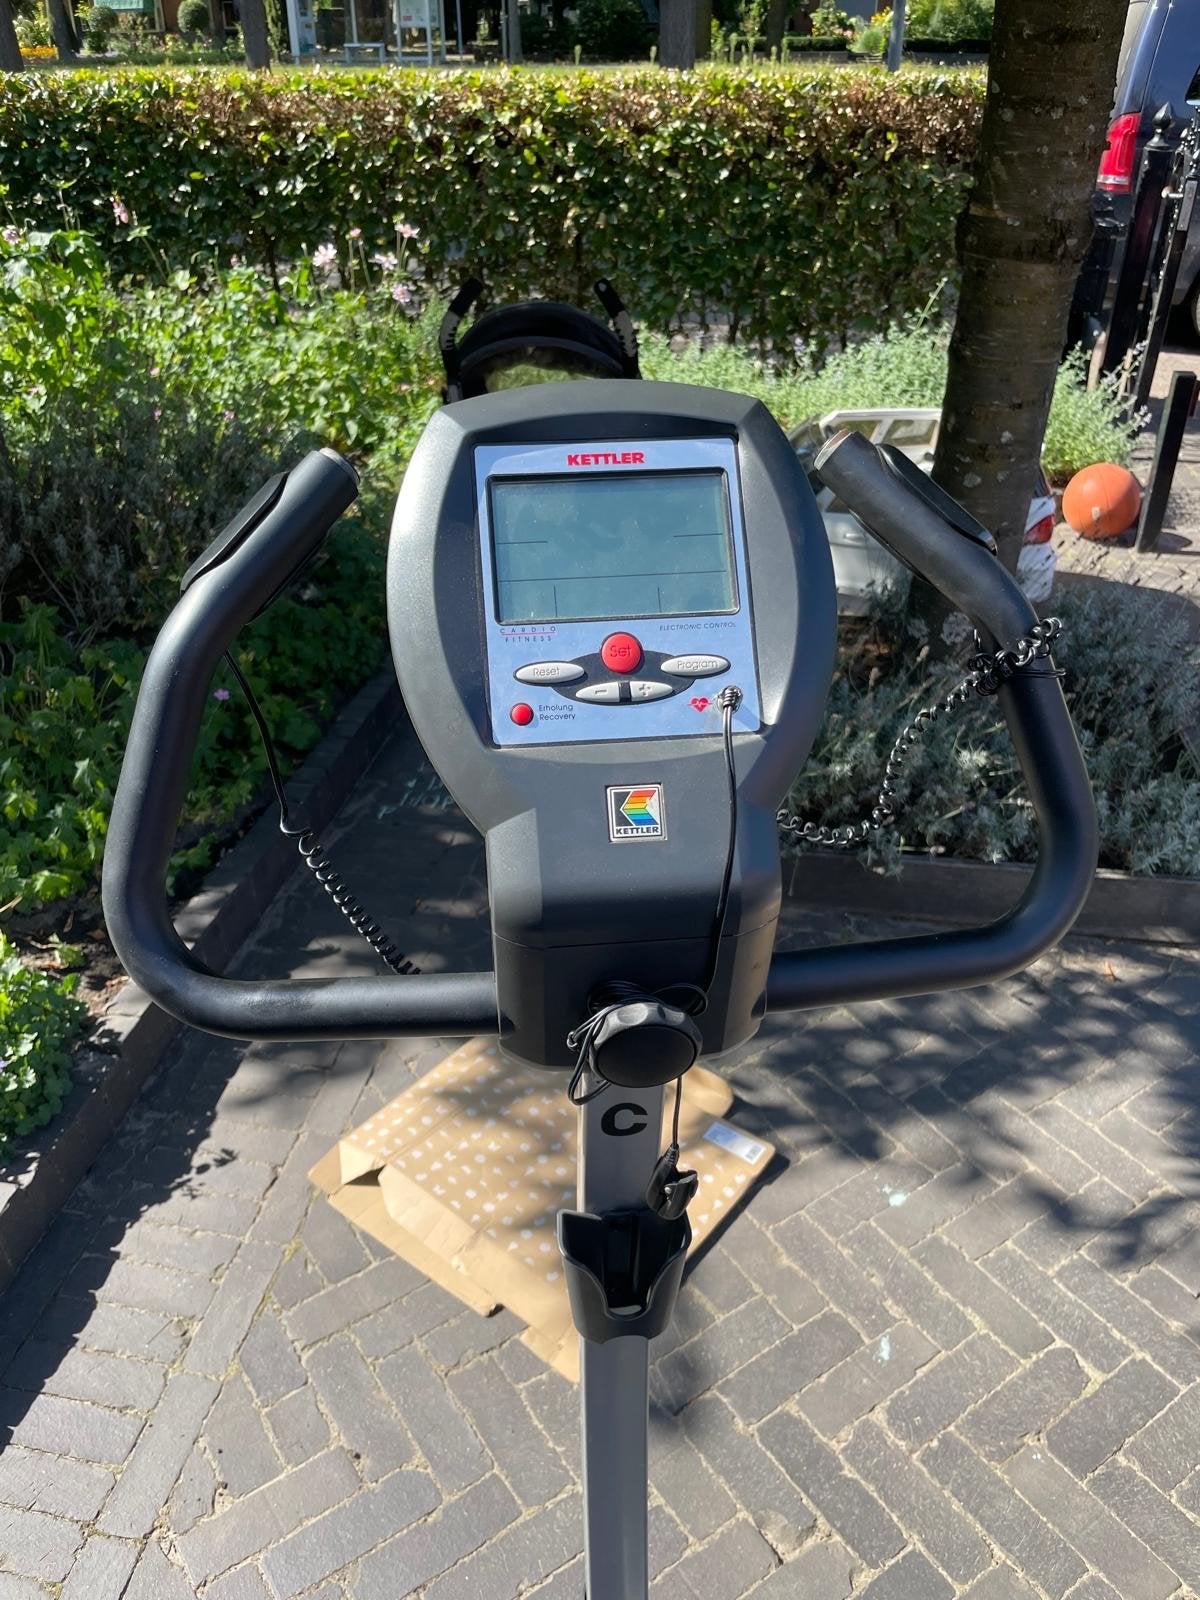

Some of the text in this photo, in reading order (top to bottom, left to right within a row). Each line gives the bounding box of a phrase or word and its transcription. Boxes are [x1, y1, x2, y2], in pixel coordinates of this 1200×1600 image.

[567, 452, 645, 466] KETTLER
[659, 623, 702, 631] ELECTRONIC
[505, 635, 552, 643] FITNESS
[610, 645, 632, 658] Set
[677, 659, 719, 671] Program
[533, 666, 561, 677] Reset
[538, 704, 574, 713] Erholung
[539, 713, 576, 721] Recovery
[615, 826, 660, 835] KETTLER
[600, 1102, 649, 1137] C
